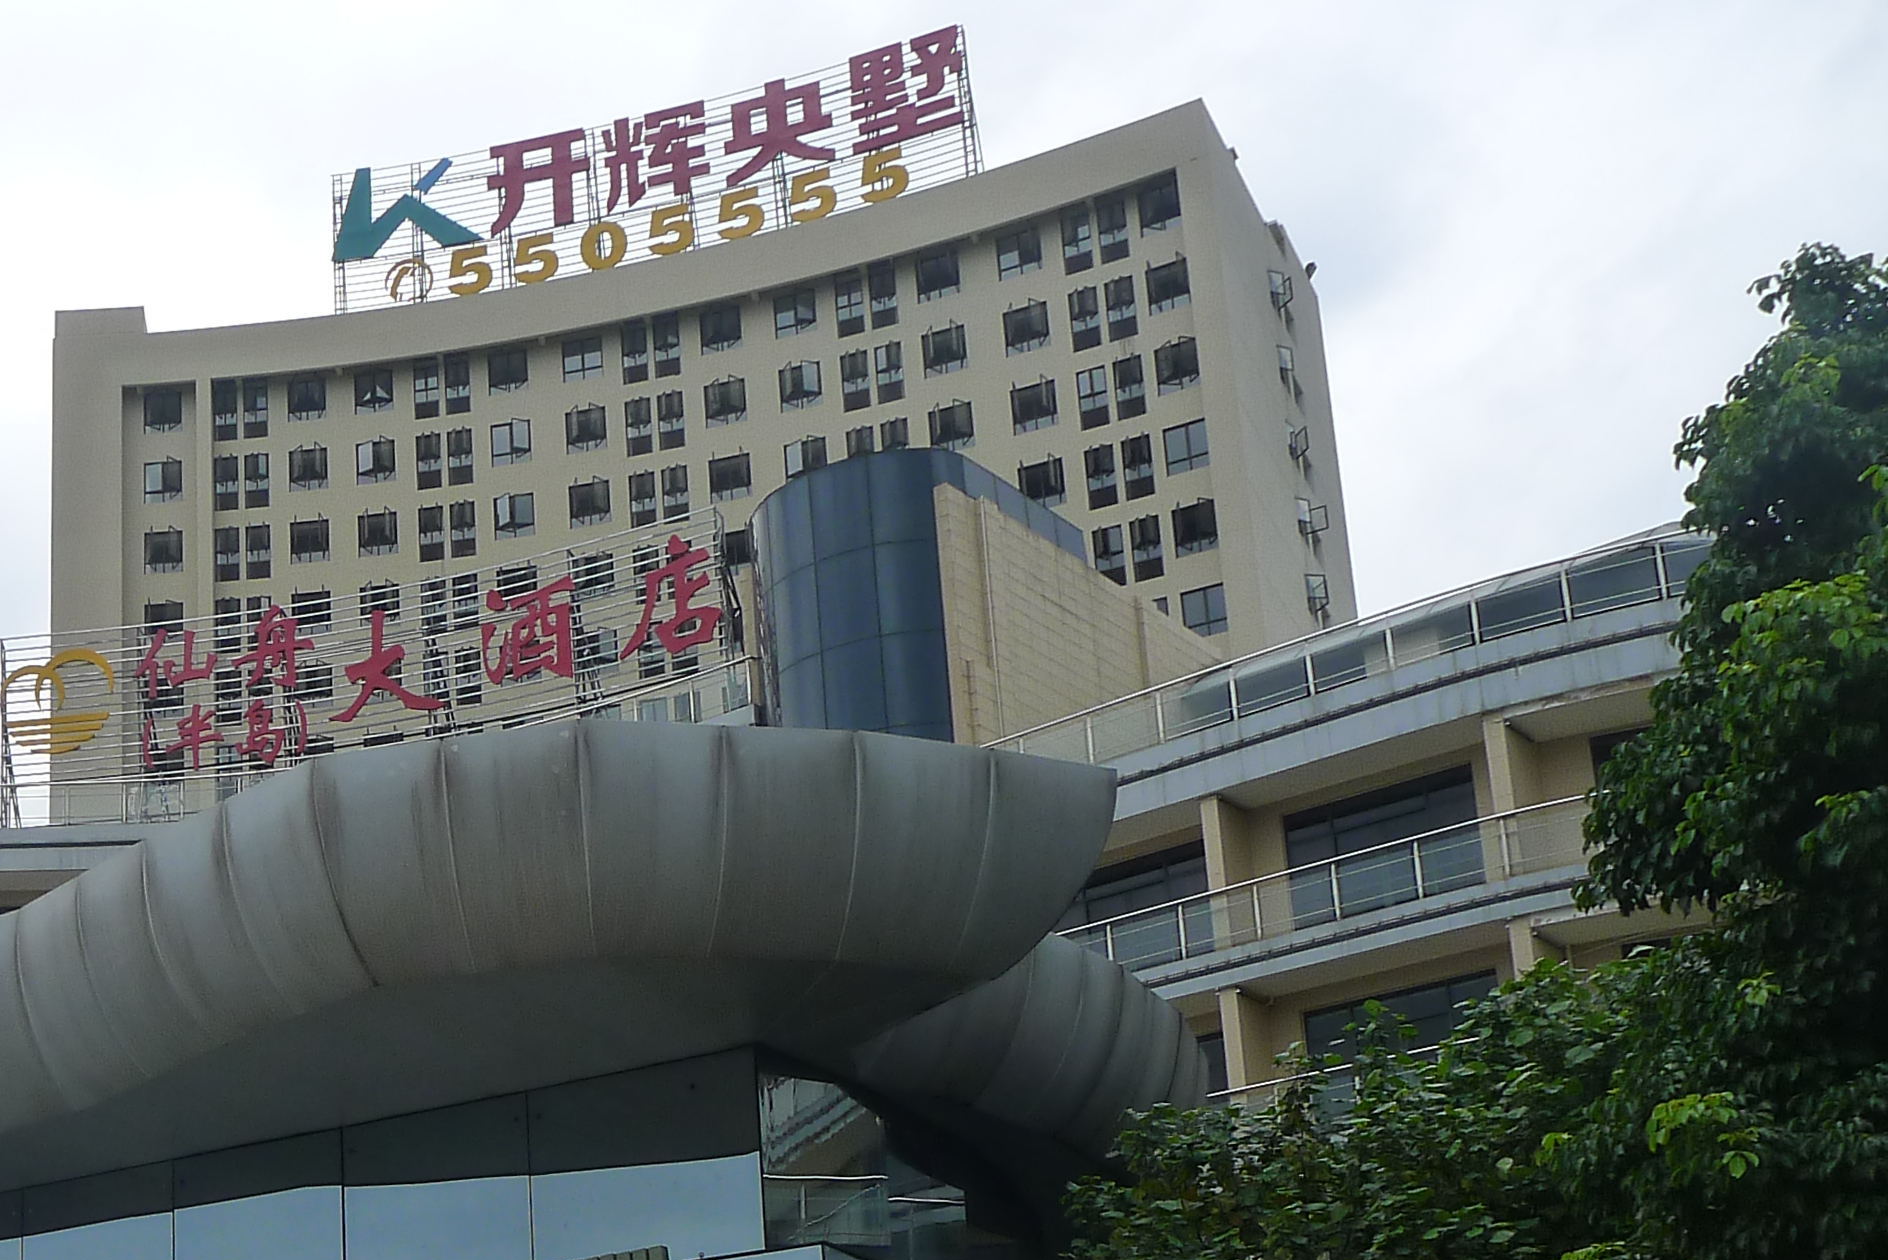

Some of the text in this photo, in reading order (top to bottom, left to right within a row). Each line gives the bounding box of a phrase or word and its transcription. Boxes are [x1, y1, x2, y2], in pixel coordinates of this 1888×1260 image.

[448, 146, 910, 298] 5505555
[487, 24, 965, 238] 开辉央墅
